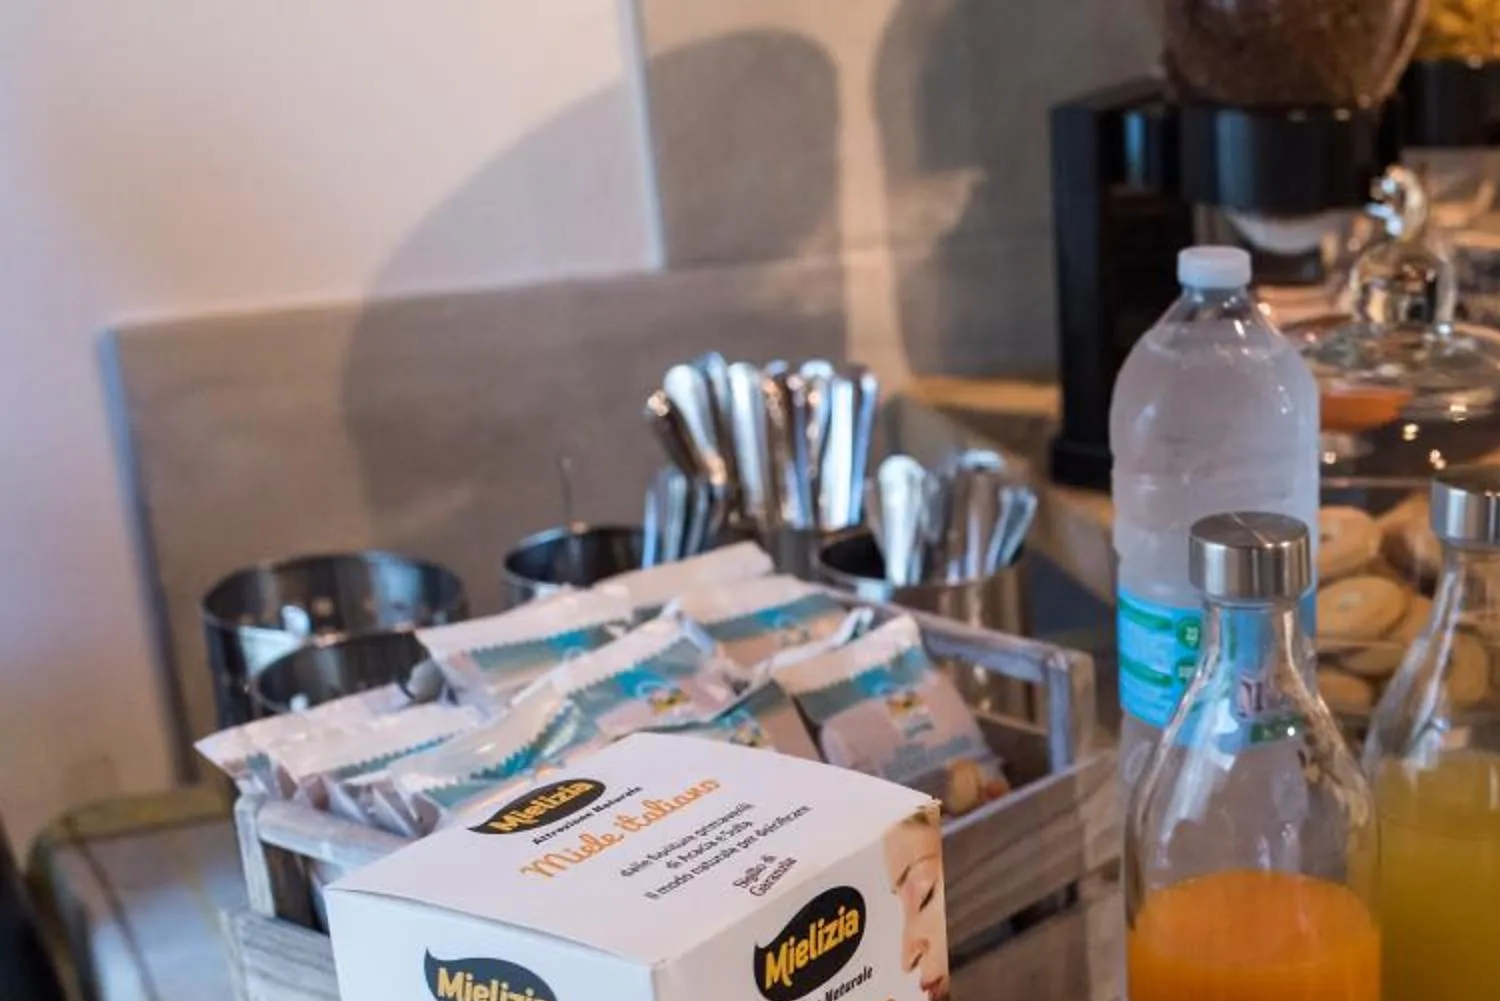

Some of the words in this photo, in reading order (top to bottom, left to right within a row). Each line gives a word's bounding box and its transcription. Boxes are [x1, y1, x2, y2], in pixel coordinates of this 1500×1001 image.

[490, 780, 594, 833] Mielizia
[520, 828, 625, 880] Miele
[613, 778, 720, 834] italiano
[765, 905, 859, 990] Mielizia
